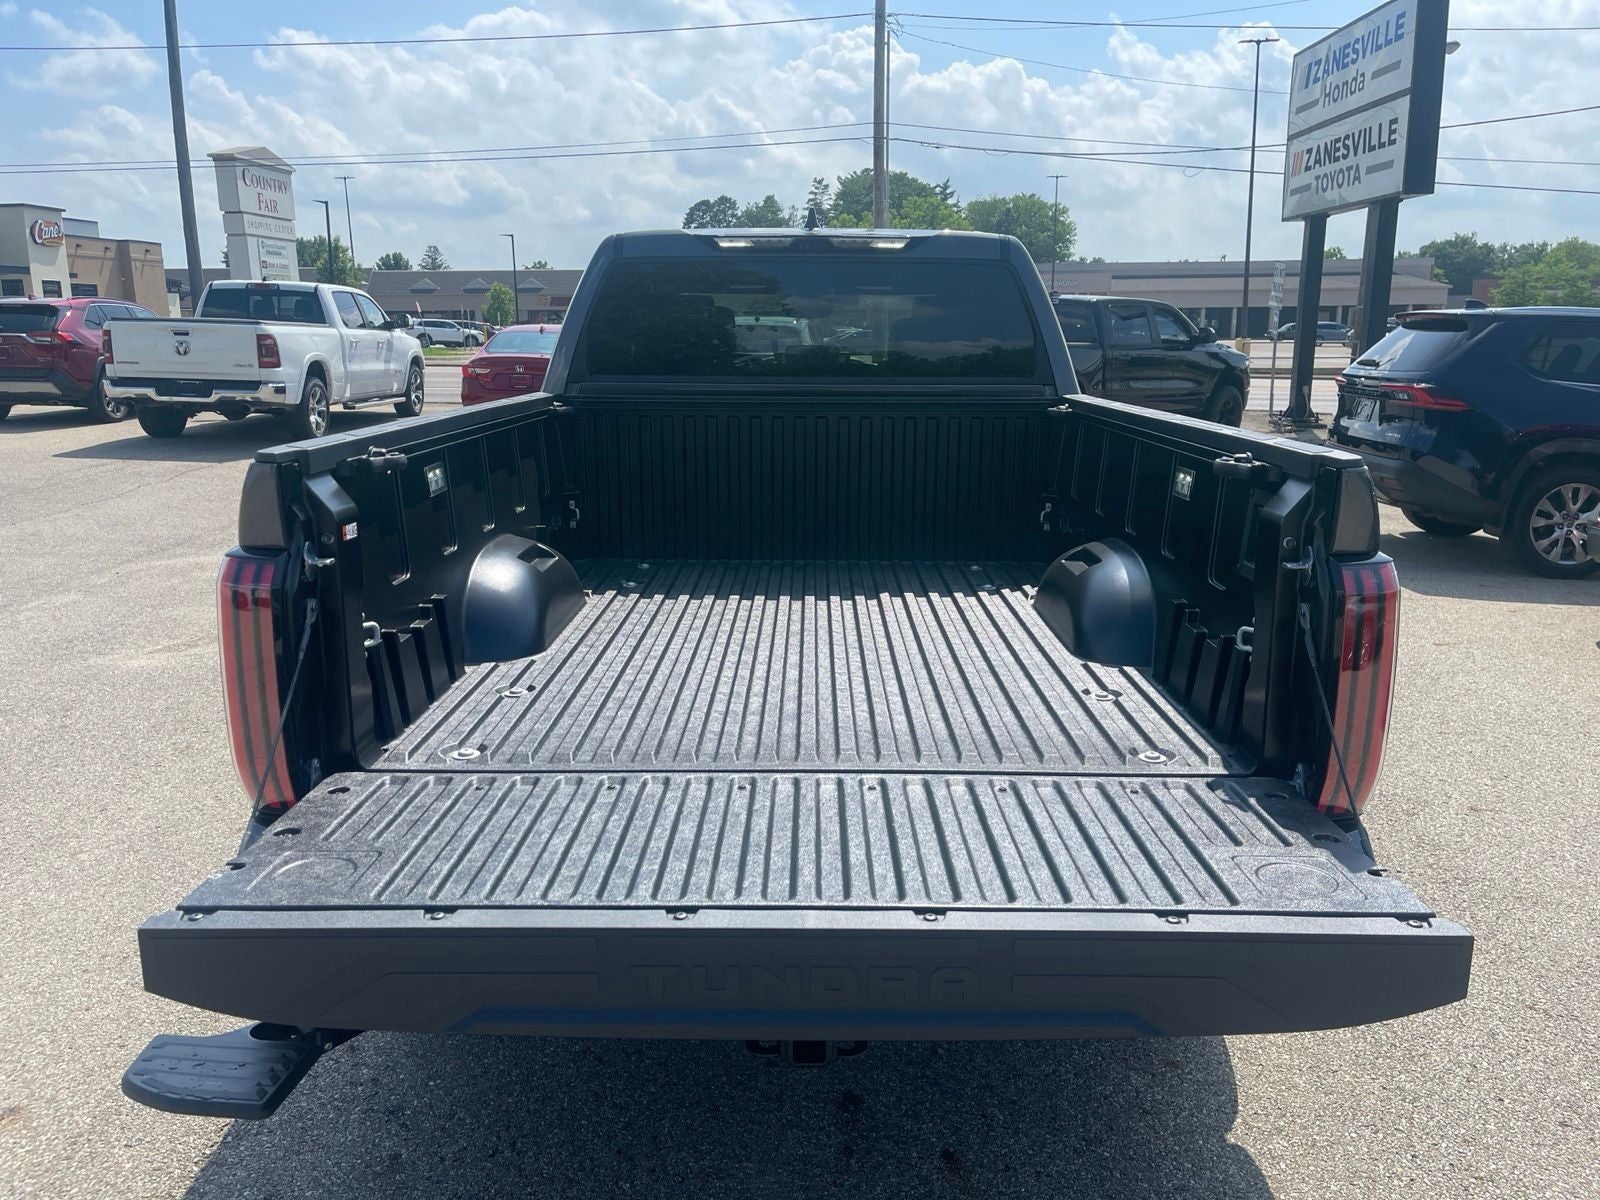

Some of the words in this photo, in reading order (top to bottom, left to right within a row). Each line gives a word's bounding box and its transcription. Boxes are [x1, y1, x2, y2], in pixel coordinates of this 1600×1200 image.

[1312, 11, 1406, 85] ZANESVILLE
[1322, 68, 1366, 108] Honda
[1304, 117, 1399, 173] ZANESVILLE
[242, 168, 288, 195] COUNTRY
[1314, 163, 1362, 195] TOYOTA
[256, 192, 279, 214] FAIR
[630, 965, 979, 1001] TUNDRA
